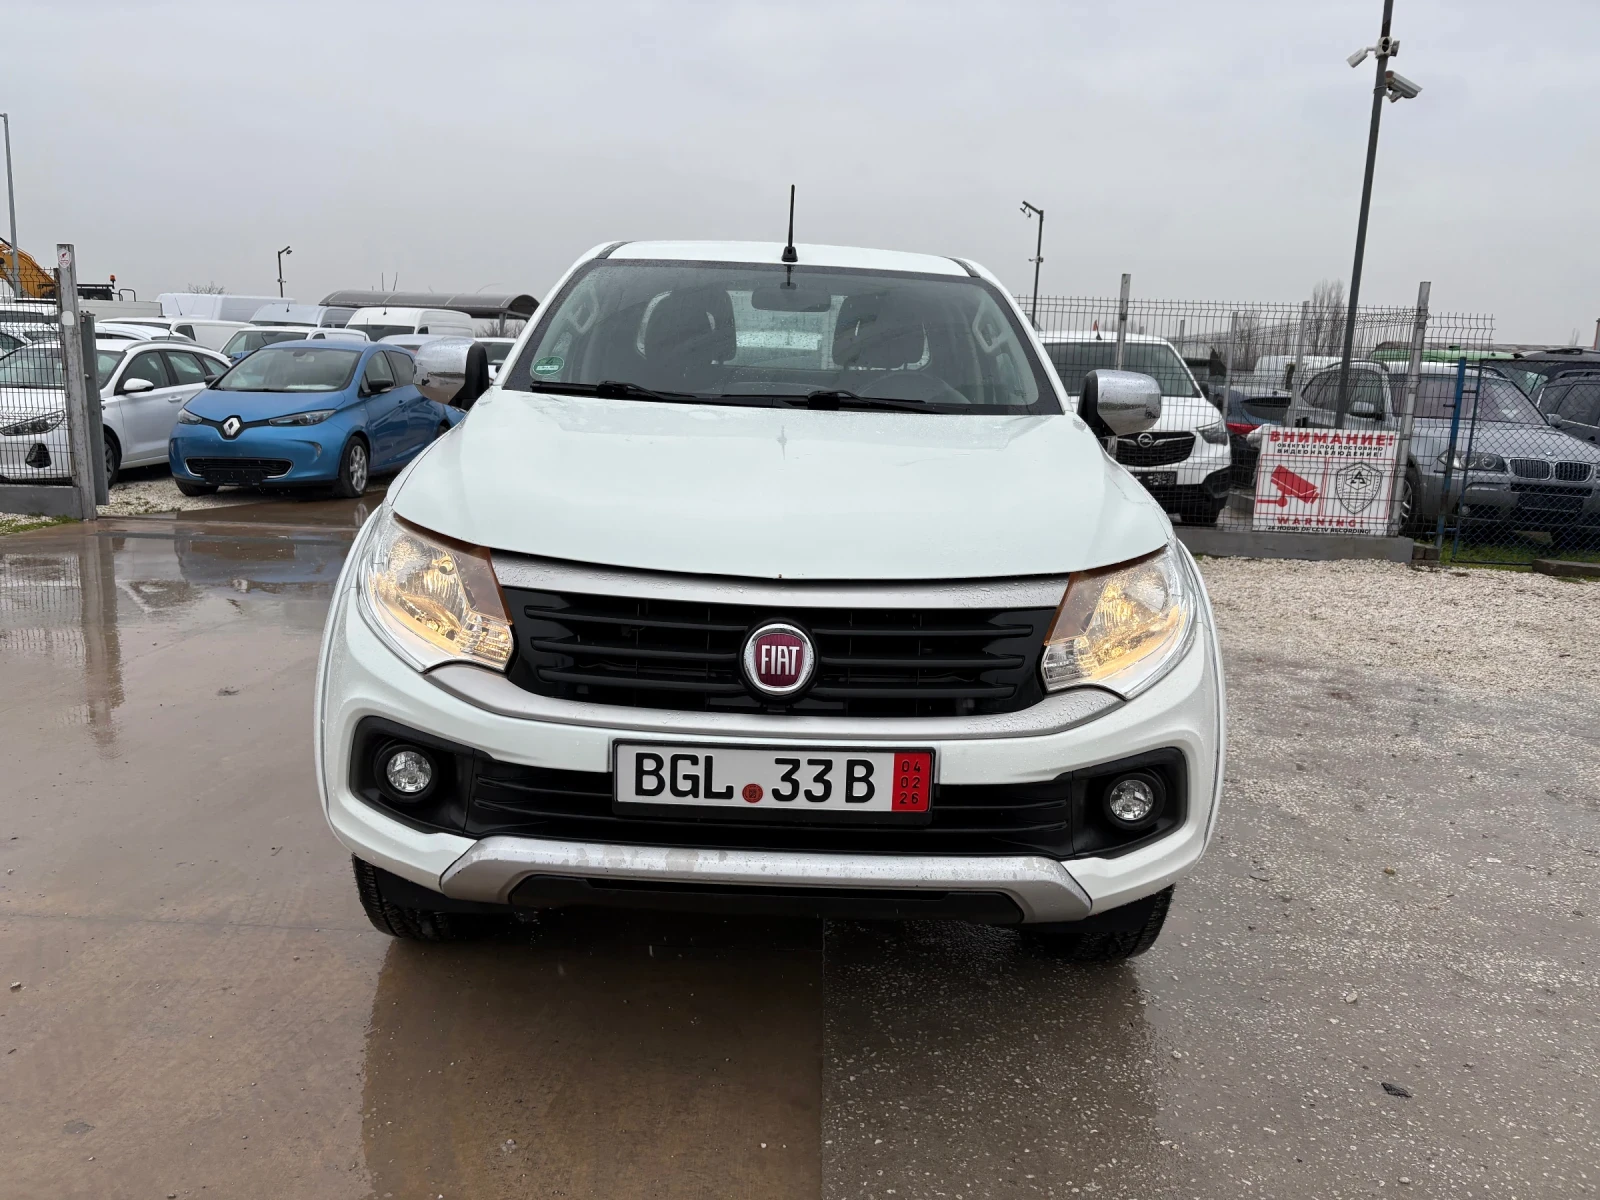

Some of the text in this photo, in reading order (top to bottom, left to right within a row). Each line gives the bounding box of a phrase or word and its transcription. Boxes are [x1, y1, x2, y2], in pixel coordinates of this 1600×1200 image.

[1269, 431, 1394, 446] ВНИМАНИЕ!
[1277, 516, 1364, 527] WARNING!
[761, 645, 800, 675] FIAT
[901, 760, 921, 773] 04
[635, 752, 734, 800] BGL
[900, 776, 921, 789] 02
[899, 792, 919, 805] 26
